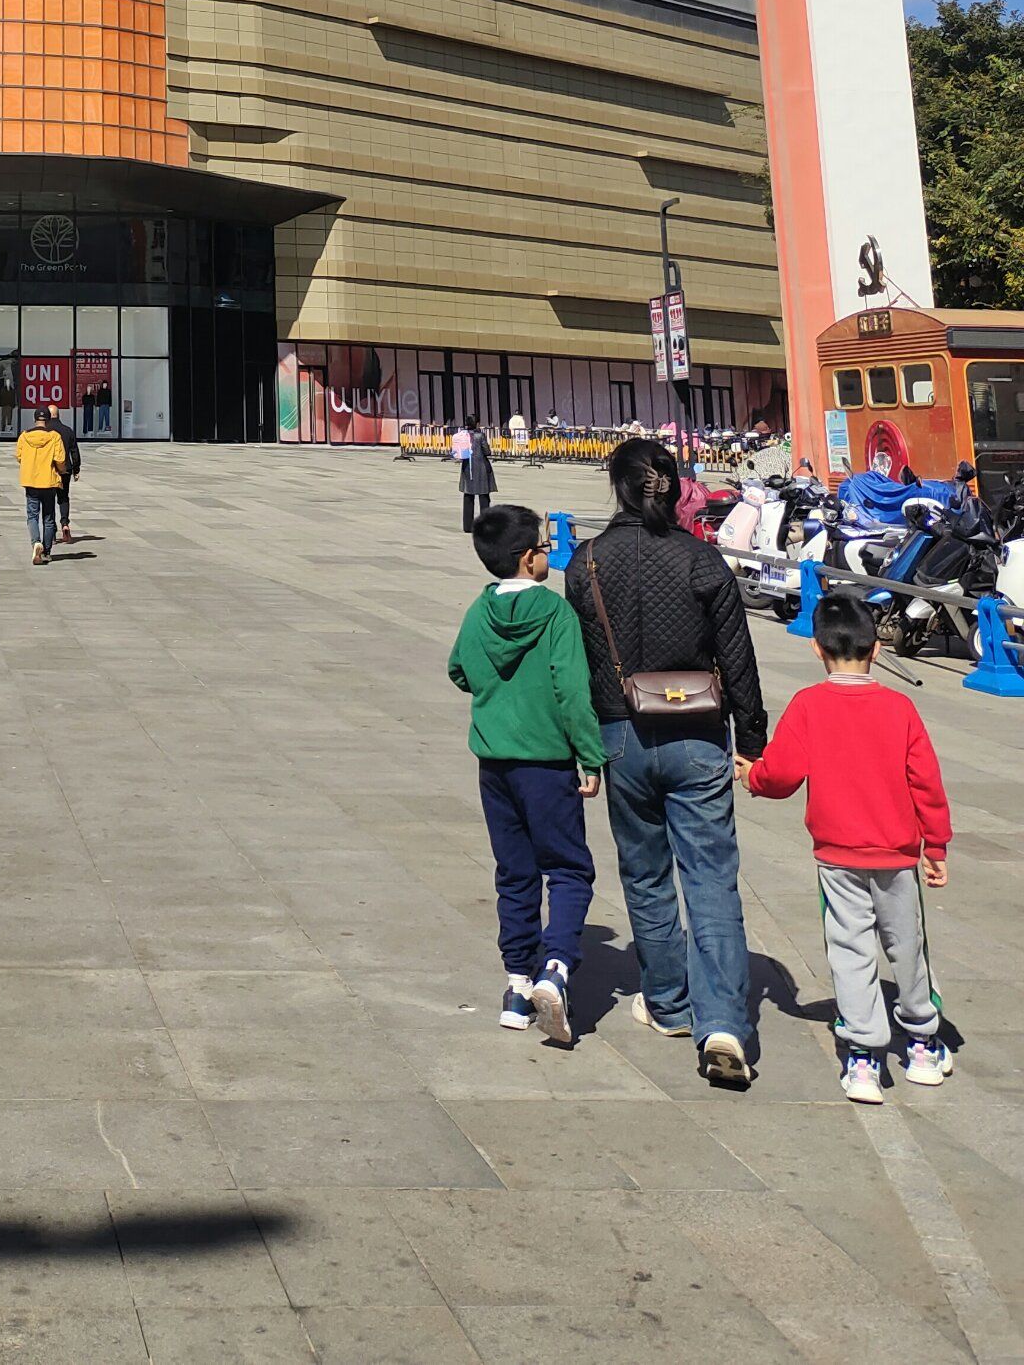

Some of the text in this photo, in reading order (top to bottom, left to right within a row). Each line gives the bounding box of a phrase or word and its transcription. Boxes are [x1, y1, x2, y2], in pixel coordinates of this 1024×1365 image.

[36, 263, 63, 272] Green
[26, 365, 59, 381] UNI
[26, 385, 63, 404] QLO
